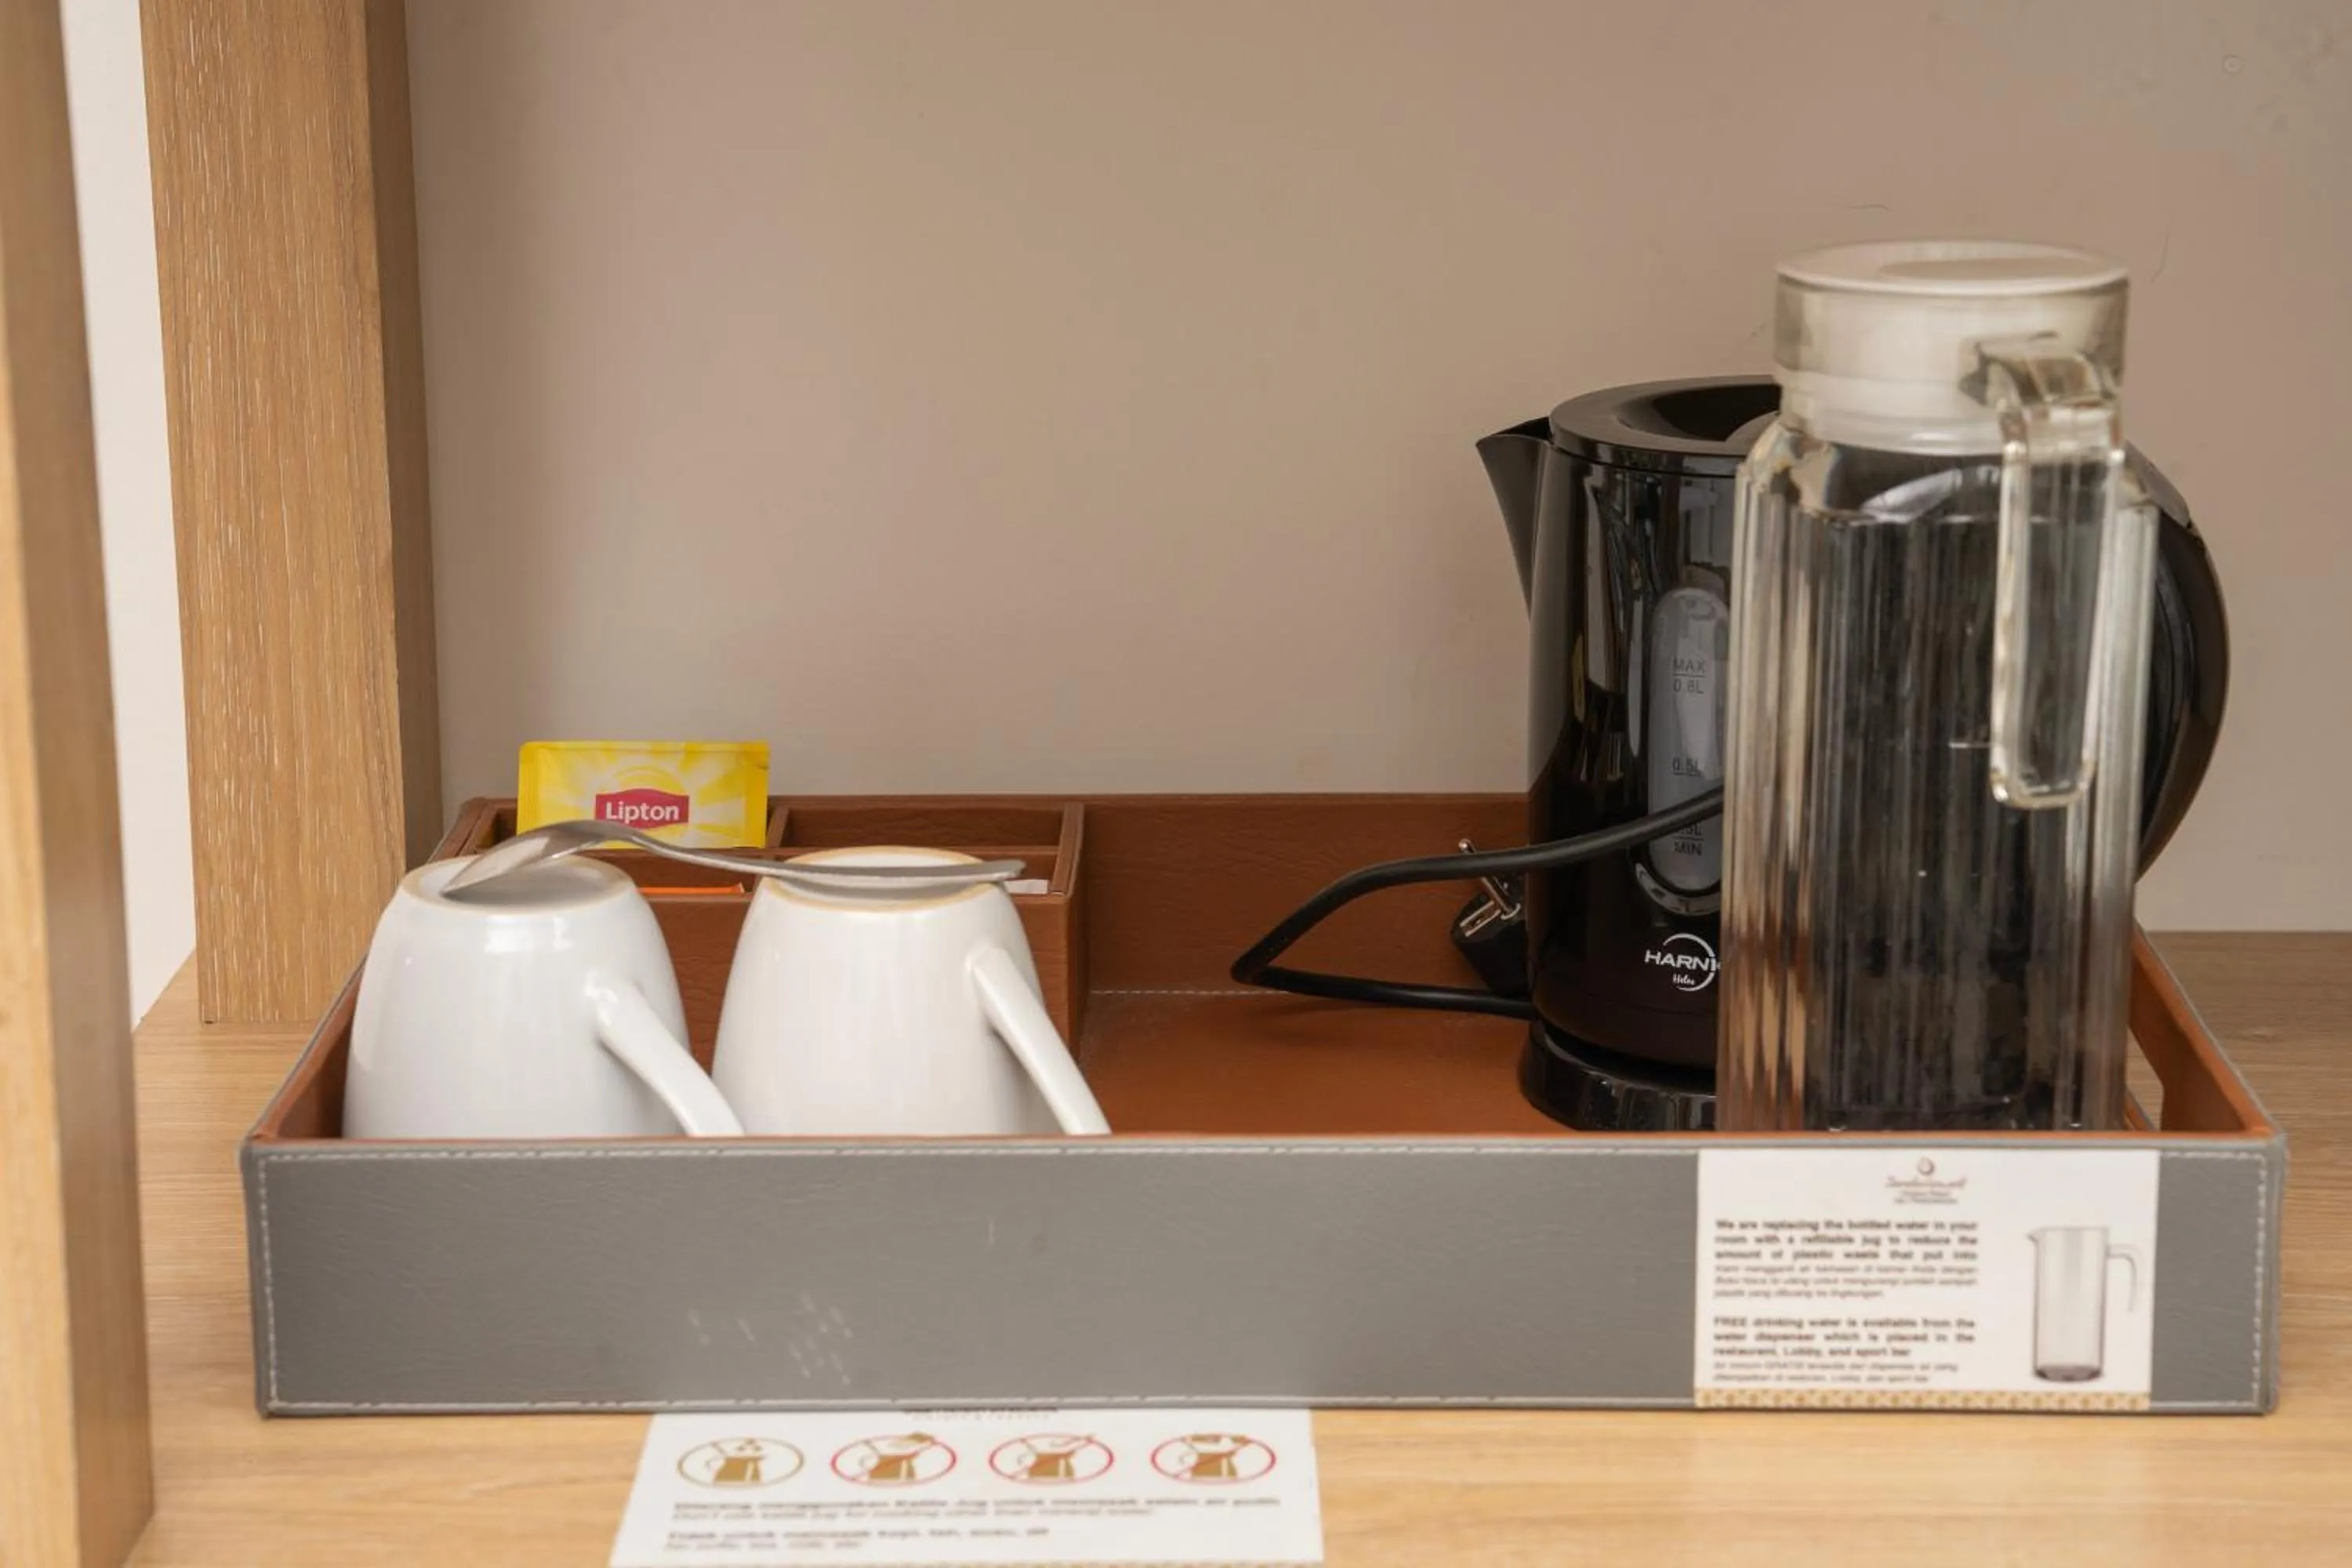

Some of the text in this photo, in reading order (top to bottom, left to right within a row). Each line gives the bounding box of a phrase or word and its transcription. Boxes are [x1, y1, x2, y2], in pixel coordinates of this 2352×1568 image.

[1672, 657, 1706, 673] MAX
[606, 801, 679, 823] Lipton
[1674, 840, 1702, 856] MIN
